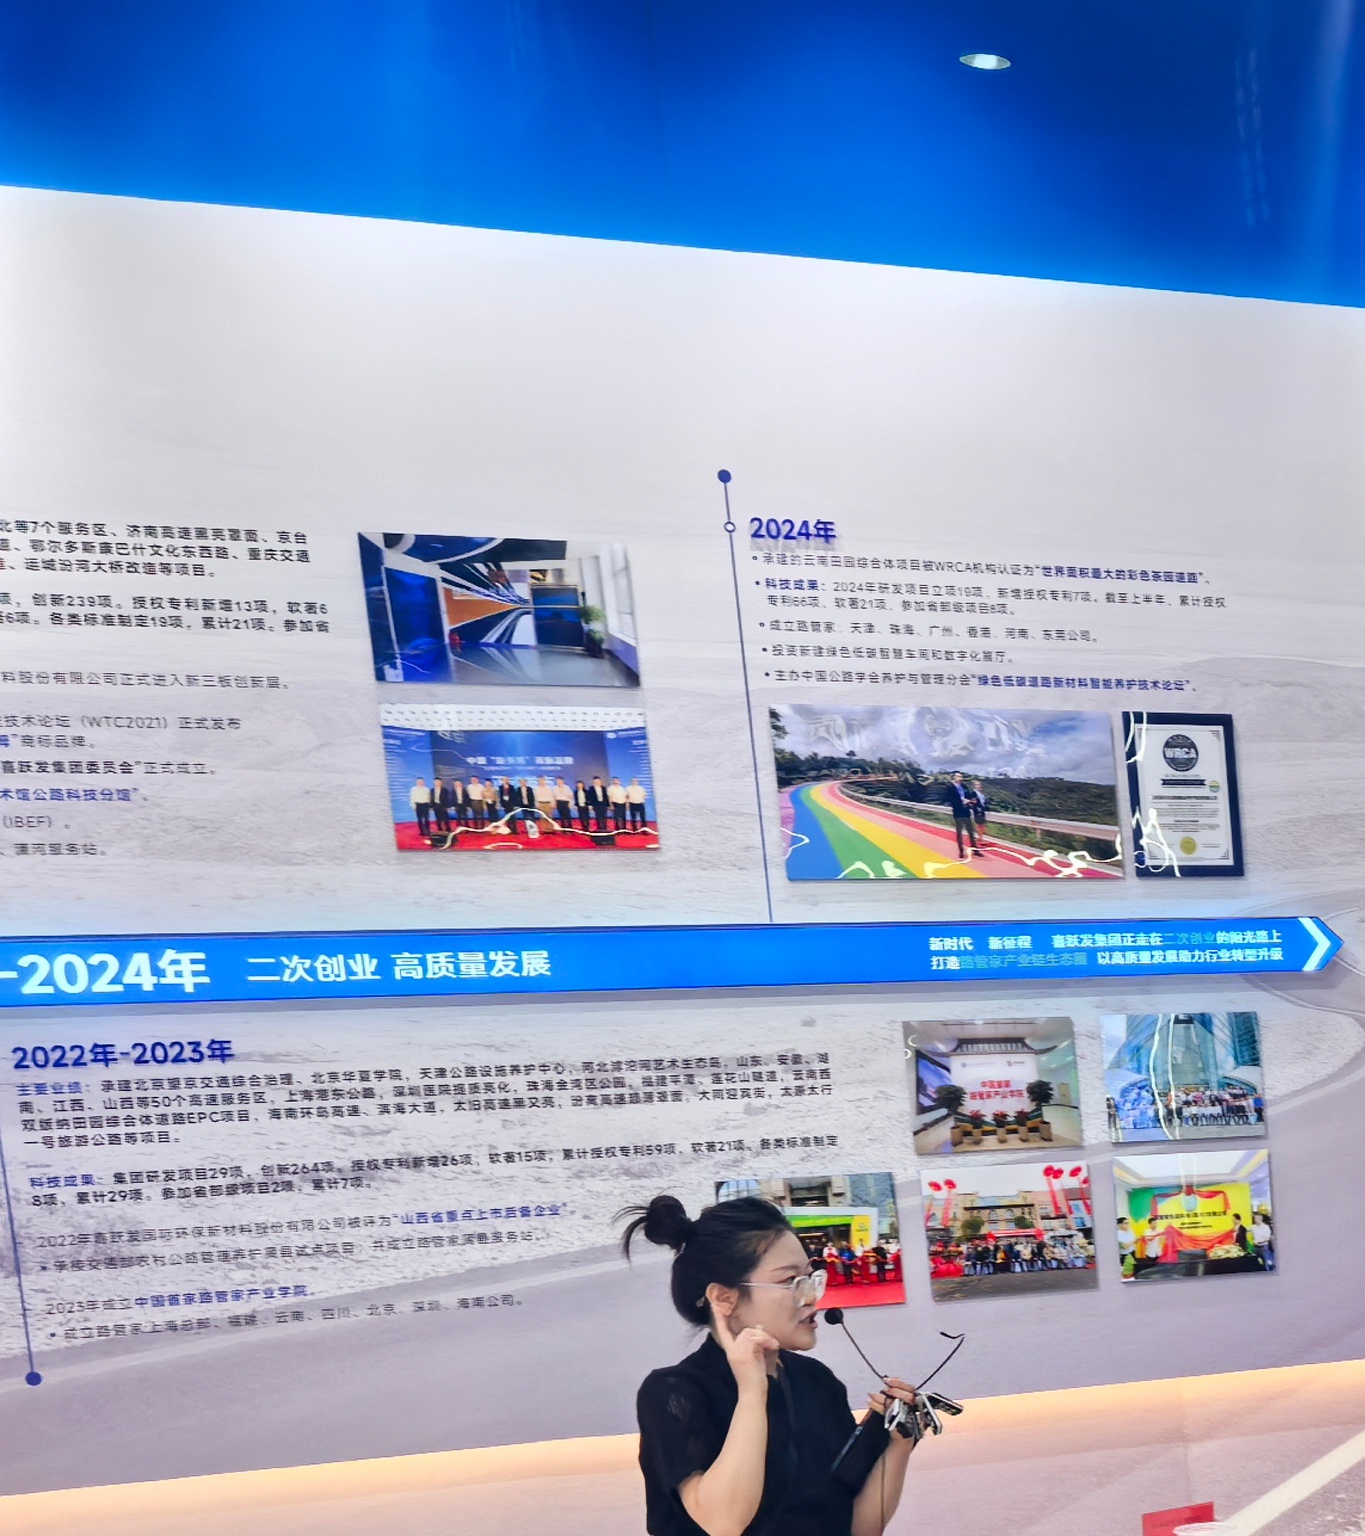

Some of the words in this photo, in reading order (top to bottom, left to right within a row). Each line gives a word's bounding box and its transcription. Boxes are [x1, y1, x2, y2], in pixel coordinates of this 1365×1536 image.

[750, 517, 837, 543] 2024年
[928, 936, 974, 951] 新时代
[987, 935, 1034, 950] 新征程
[247, 953, 380, 984] 二次创业
[391, 949, 552, 981] 高质量发展
[11, 1038, 235, 1069] 2022年-2023年
